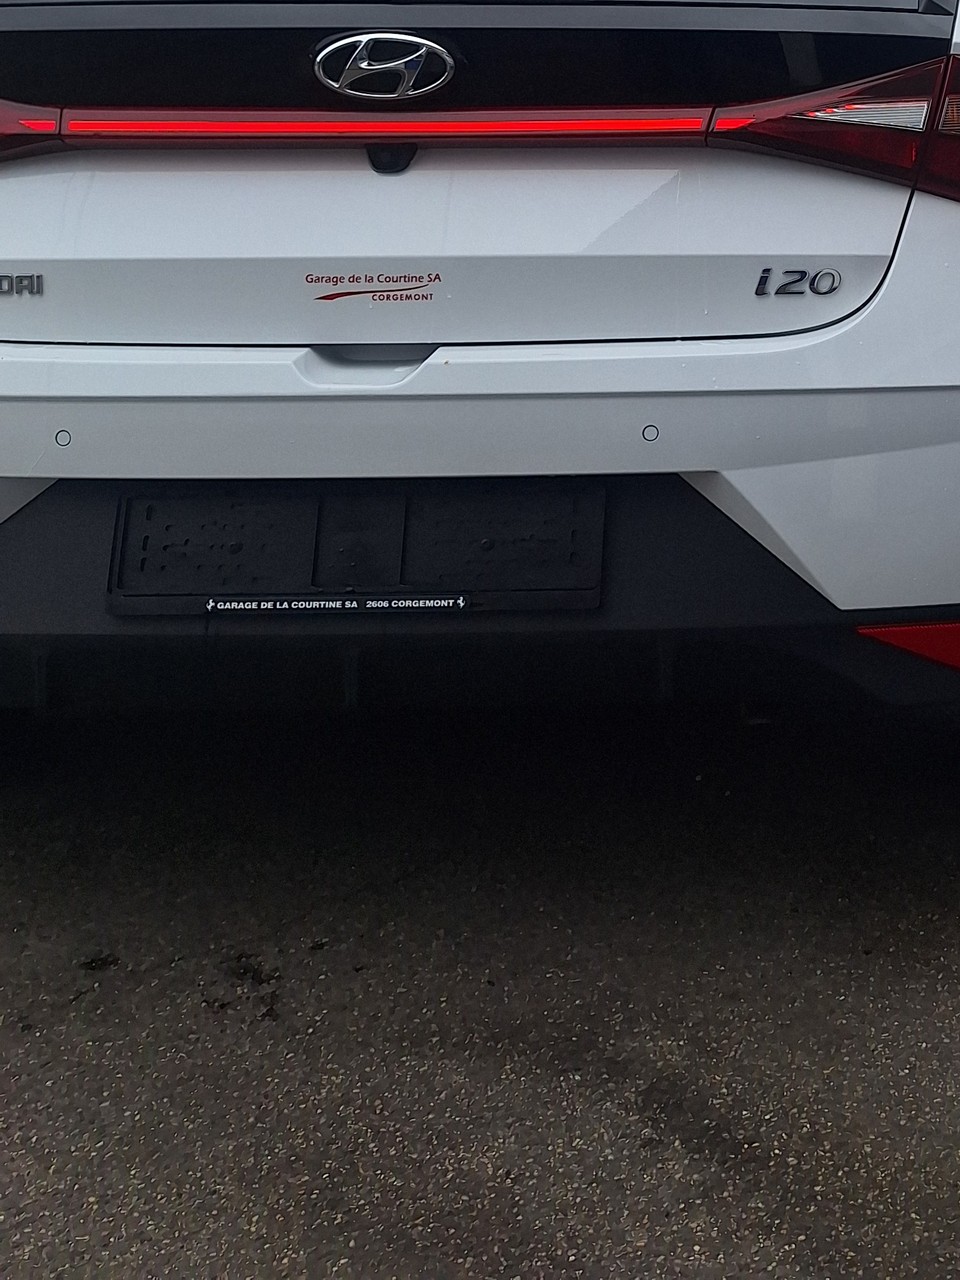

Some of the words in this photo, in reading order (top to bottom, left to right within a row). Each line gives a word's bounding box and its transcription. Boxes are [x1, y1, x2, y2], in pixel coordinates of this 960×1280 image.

[305, 274, 345, 286] Garage
[347, 274, 362, 283] de
[364, 274, 374, 283] la
[376, 273, 425, 283] Courtine
[427, 273, 442, 283] SA
[754, 267, 842, 296] i20
[371, 293, 434, 301] CORGEMONT
[216, 601, 258, 609] GARAGE
[260, 601, 274, 609] DE
[276, 601, 289, 609] LA
[291, 601, 343, 609] COURTINE
[391, 599, 454, 607] CORGEMONT
